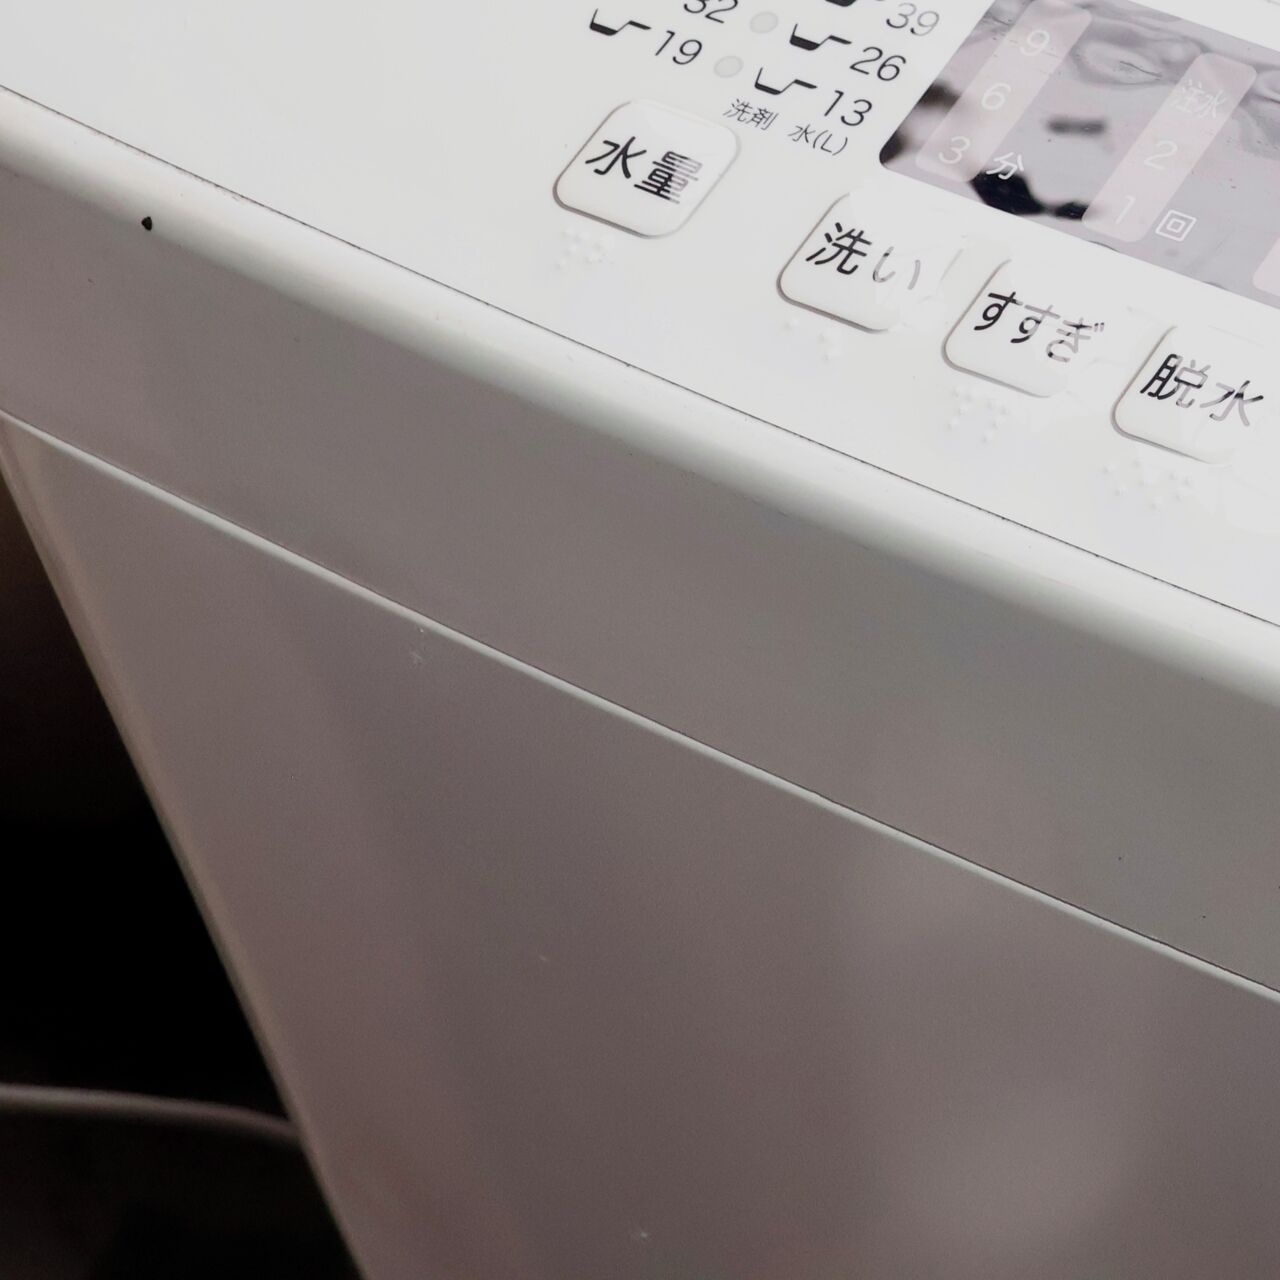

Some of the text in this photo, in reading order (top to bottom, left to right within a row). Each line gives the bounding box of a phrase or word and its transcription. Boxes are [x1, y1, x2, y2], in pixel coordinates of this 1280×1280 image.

[885, 1, 941, 38] 39
[653, 29, 703, 67] 19
[1018, 29, 1051, 58] 9
[849, 45, 907, 83] 26
[722, 97, 780, 132] 洗剤
[823, 89, 874, 127] 13
[980, 82, 1012, 111] 6
[584, 135, 705, 206] 水量
[937, 136, 1025, 181] 3 分
[1143, 140, 1179, 170] 2
[805, 222, 923, 291] 洗い
[973, 291, 1106, 363] すすぎ
[1139, 353, 1265, 428] 脱水
